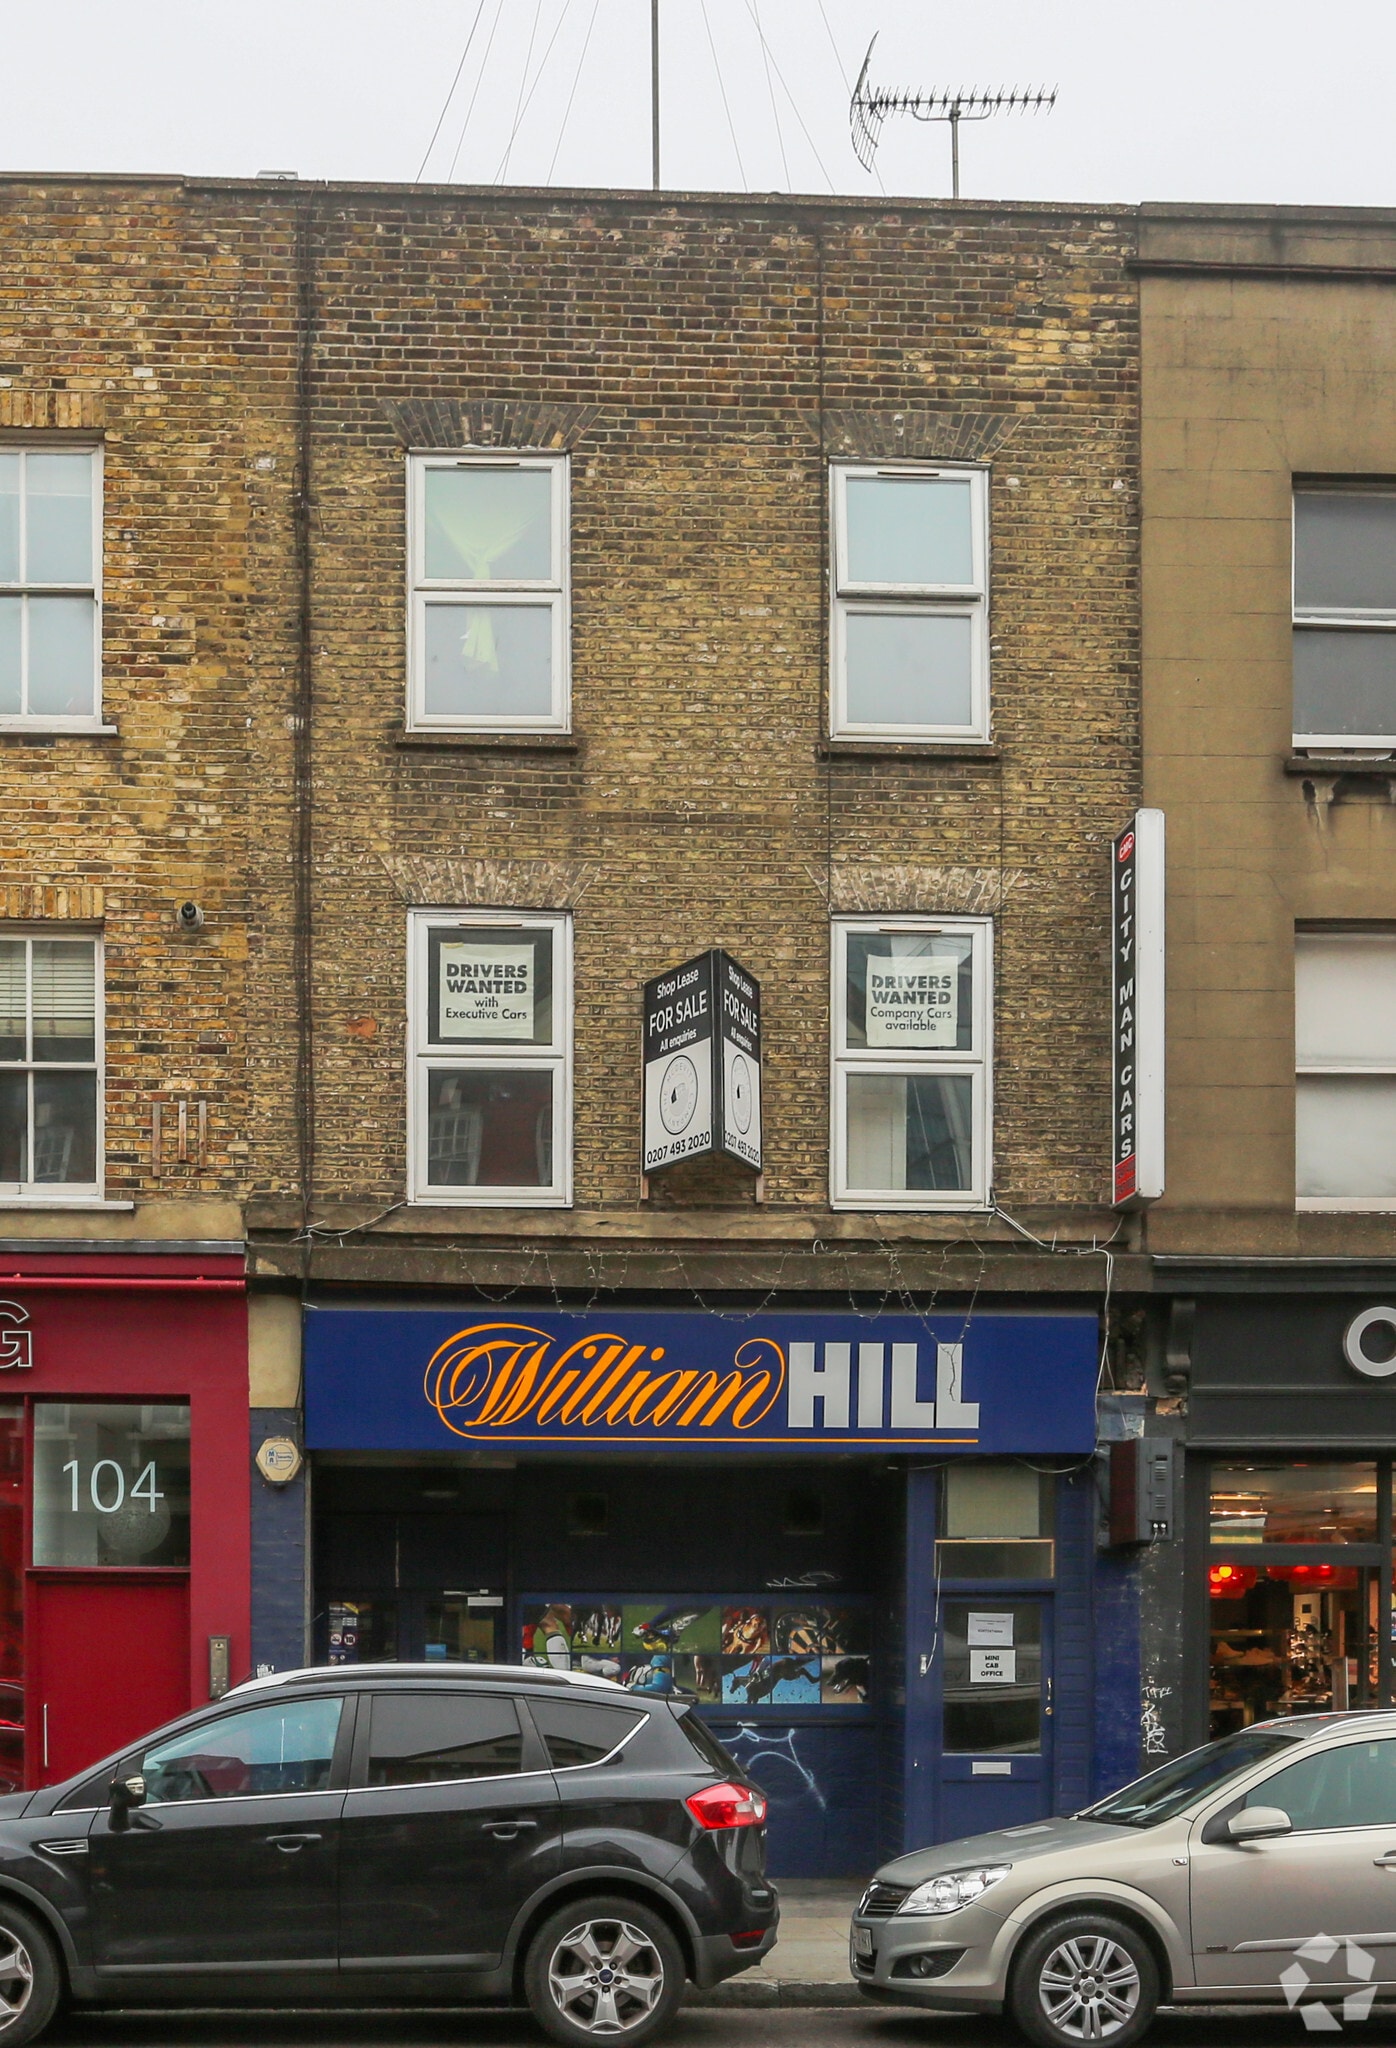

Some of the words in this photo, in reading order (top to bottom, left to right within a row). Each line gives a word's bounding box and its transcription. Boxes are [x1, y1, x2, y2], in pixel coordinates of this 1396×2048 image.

[1120, 868, 1132, 962] CITY
[446, 963, 528, 978] DRIVERS
[871, 974, 952, 989] DRIVERS
[446, 980, 527, 994] WANTED
[657, 982, 676, 1000] Shop
[677, 969, 699, 990] Lease
[871, 990, 951, 1005] WANTED
[446, 1007, 498, 1019] Executive
[502, 1009, 527, 1020] Cars
[474, 996, 499, 1008] with
[649, 1006, 673, 1037] FOR
[676, 989, 708, 1024] SALE
[724, 988, 739, 1022] FOR
[740, 1002, 757, 1036] SALE
[870, 1006, 923, 1021] Company
[927, 1008, 952, 1019] Cars
[1119, 977, 1133, 1053] MAN
[885, 1019, 937, 1031] available
[660, 1038, 669, 1052] All
[669, 1028, 697, 1048] enquiries
[1120, 1065, 1132, 1158] CARS
[647, 1145, 668, 1164] 0207
[670, 1139, 686, 1155] 493
[688, 1131, 710, 1151] 2020
[424, 1322, 786, 1434] William
[788, 1342, 979, 1429] HILL
[62, 1459, 165, 1513] 104
